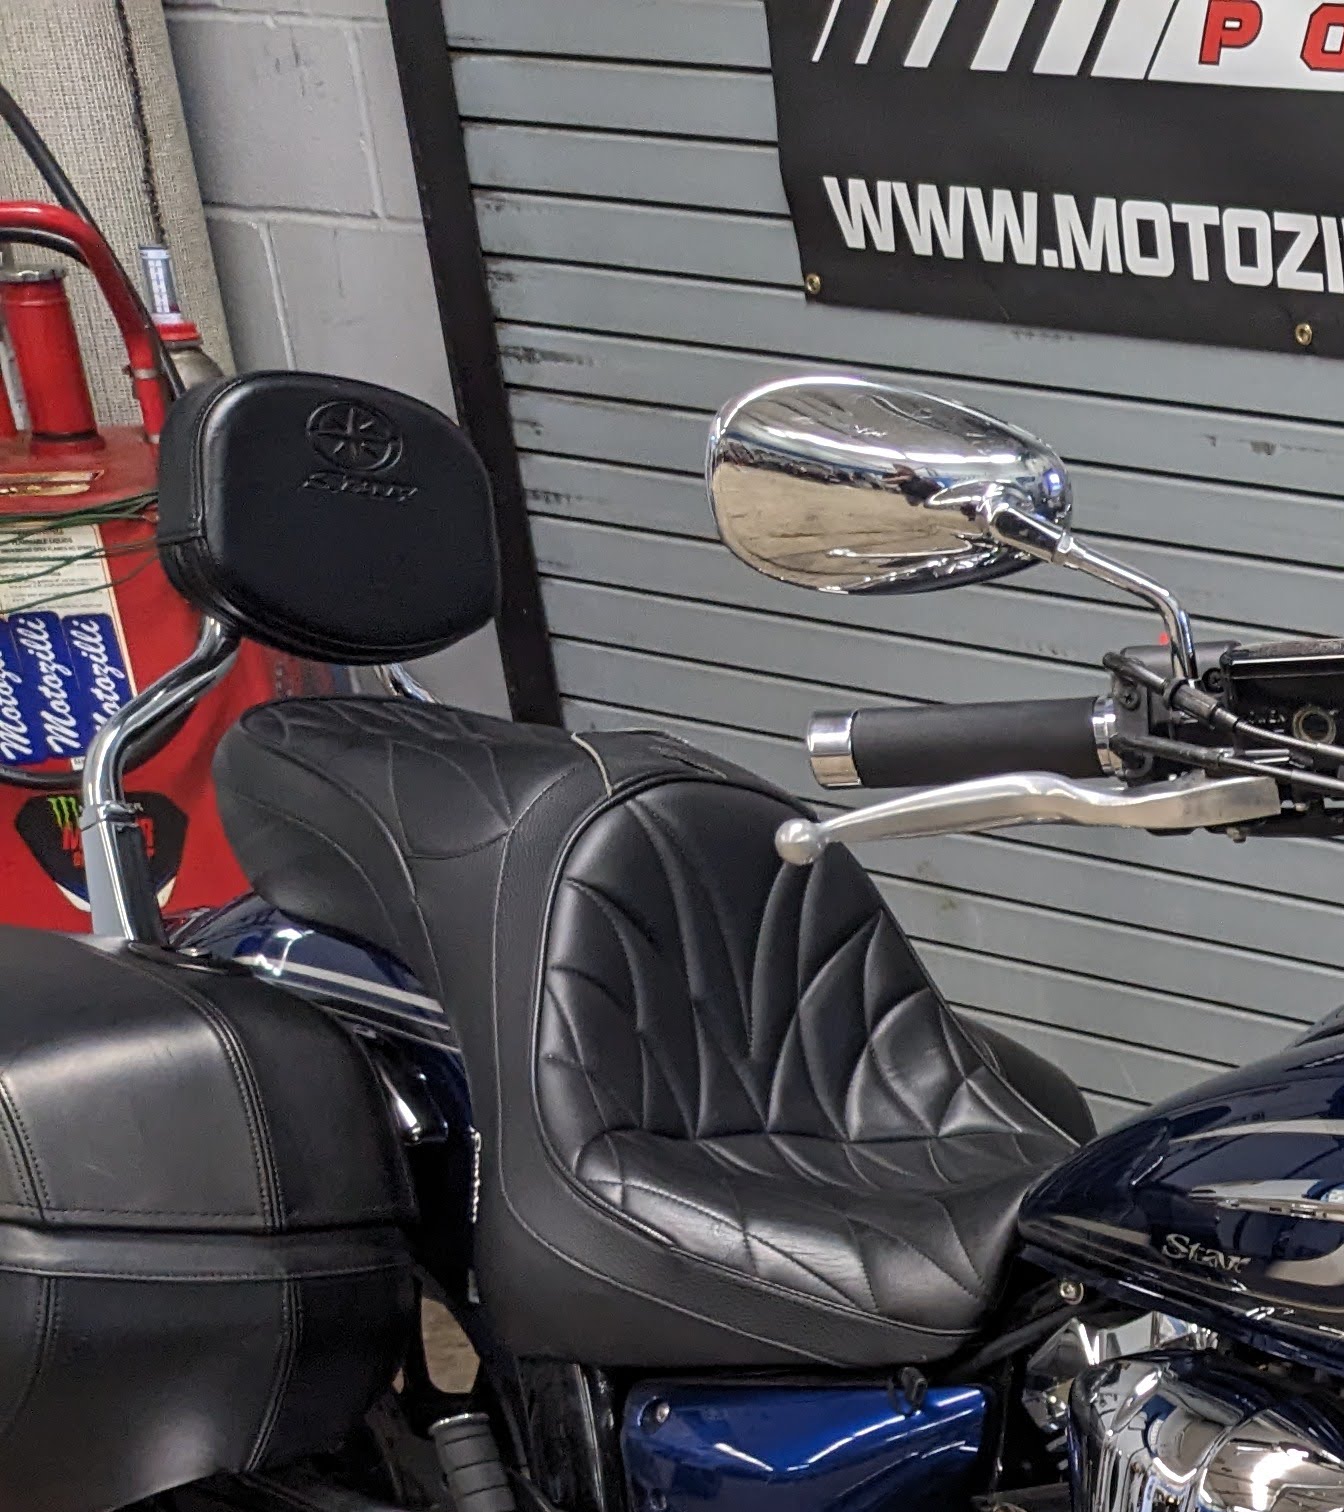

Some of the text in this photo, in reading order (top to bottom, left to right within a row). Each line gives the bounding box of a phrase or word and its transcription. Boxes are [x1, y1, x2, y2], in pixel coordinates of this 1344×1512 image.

[16, 617, 82, 753] Motozilli
[70, 619, 126, 732] otozilli
[1162, 1233, 1252, 1274] Star
